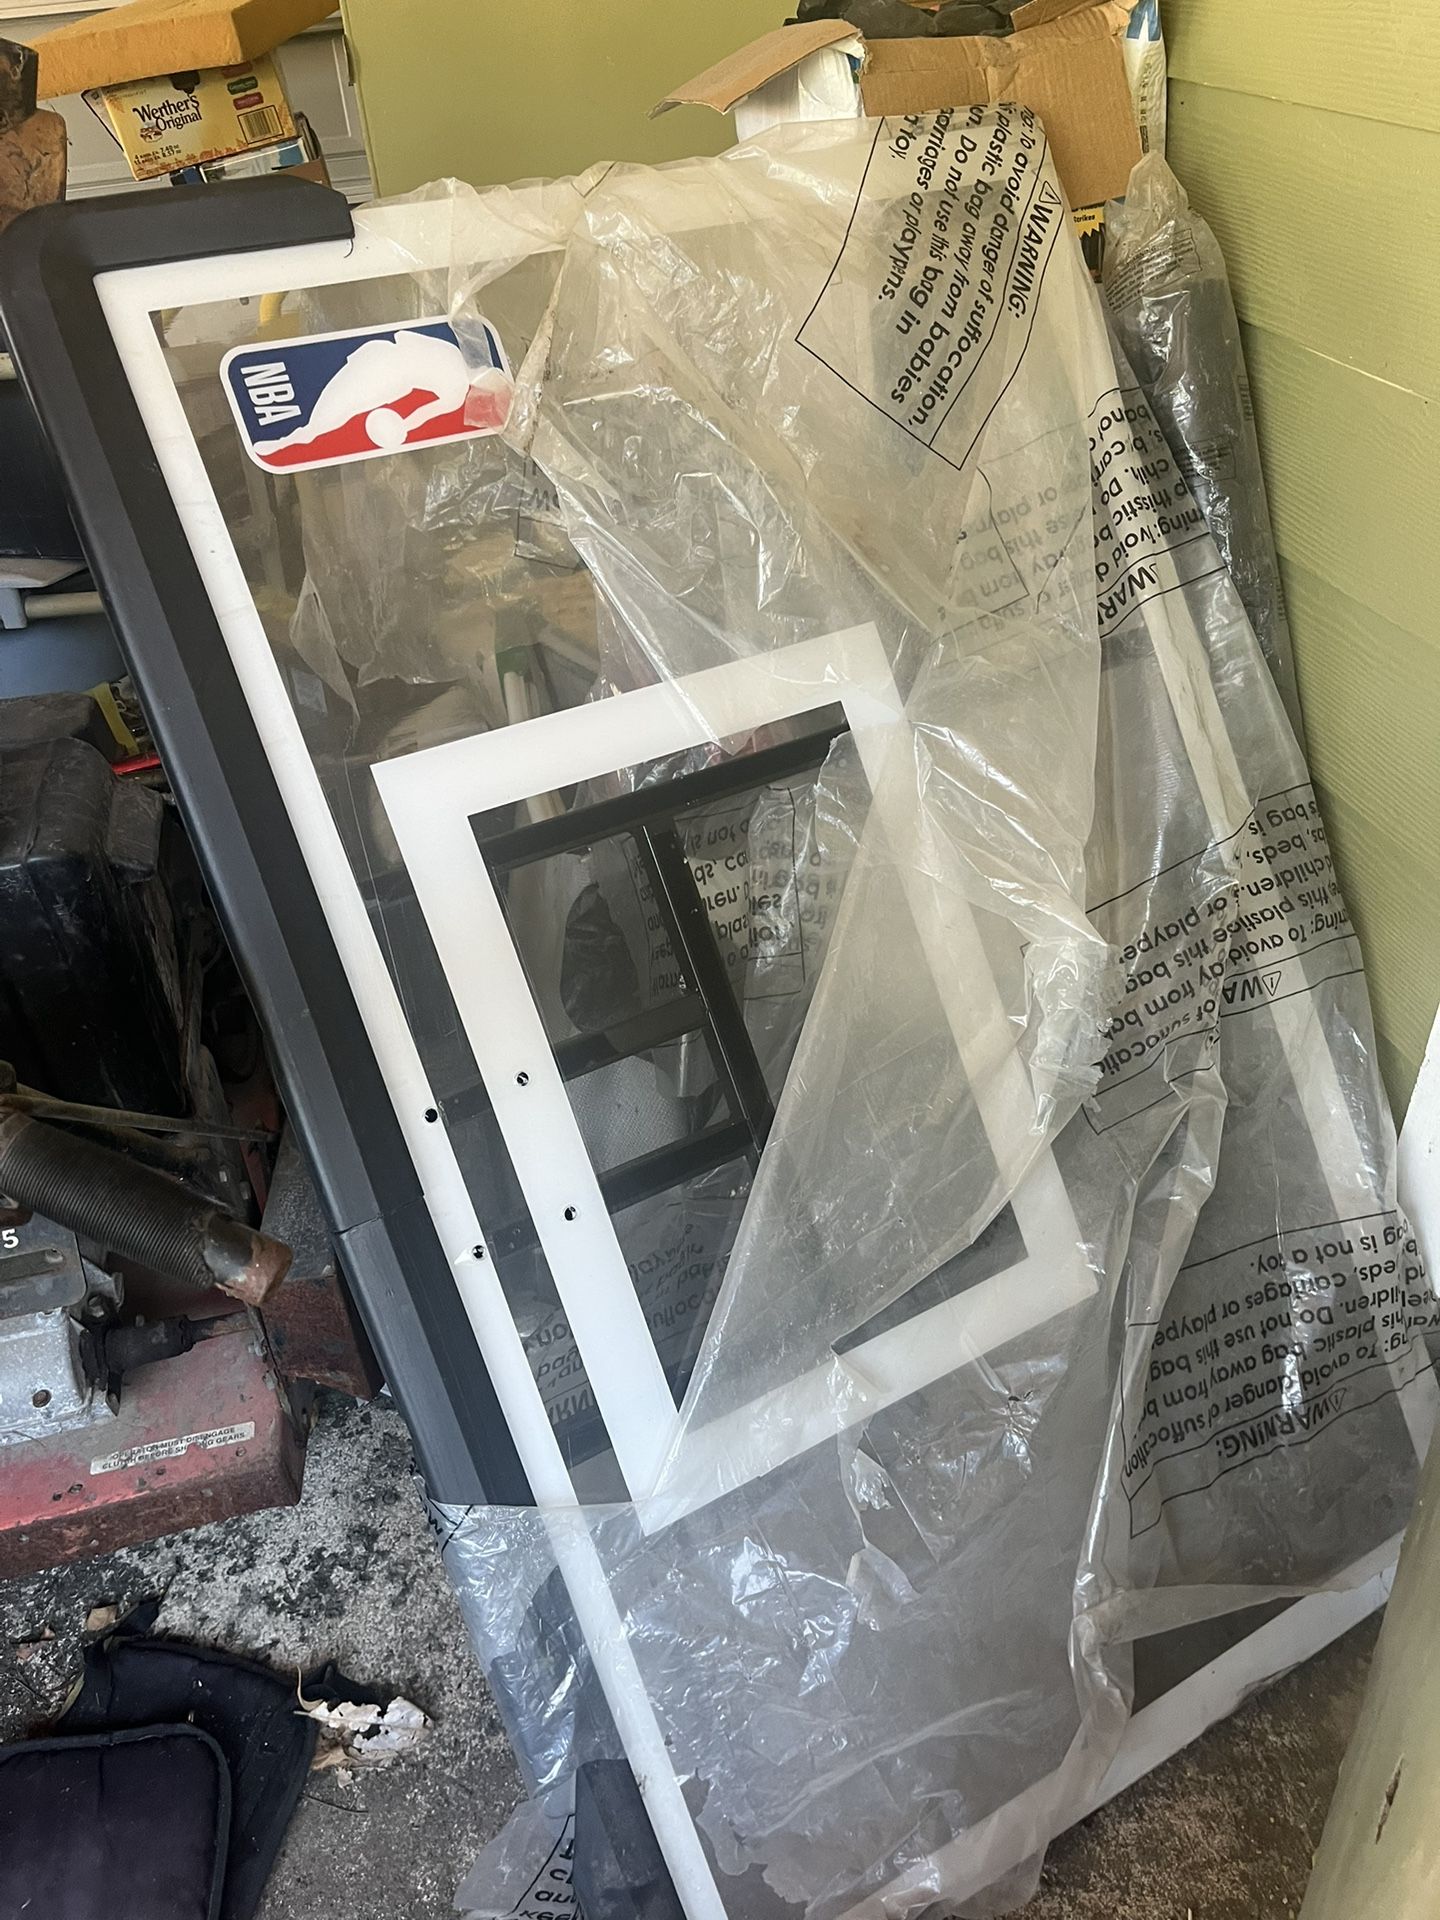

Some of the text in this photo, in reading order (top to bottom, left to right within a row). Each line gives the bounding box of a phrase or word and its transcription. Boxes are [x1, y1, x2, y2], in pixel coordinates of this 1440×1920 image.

[132, 94, 200, 123] Werther's
[155, 107, 202, 131] Original
[889, 128, 920, 160] toy.
[955, 135, 977, 163] Do
[982, 111, 1010, 176] plastic
[940, 166, 962, 201] not
[1000, 152, 1031, 215] avoid
[905, 192, 923, 215] or
[964, 179, 993, 220] bag
[934, 200, 953, 232] use
[878, 210, 922, 300] playpens.
[929, 233, 949, 261] this
[954, 222, 976, 271] away
[982, 213, 1009, 279] danger
[1008, 204, 1053, 318] WARNING:
[909, 266, 944, 309] bag
[941, 269, 969, 318] from
[977, 279, 994, 304] of
[896, 310, 920, 334] in
[891, 321, 950, 404] babies
[908, 300, 985, 425] suffocation,
[240, 361, 300, 427] NBA
[1248, 819, 1267, 836] is
[1266, 802, 1309, 827] bag
[1247, 834, 1307, 865] beds,
[1207, 897, 1227, 917] or
[1298, 887, 1329, 909] this
[1288, 924, 1307, 943] To
[1174, 938, 1212, 968] this
[1229, 935, 1283, 972] avoid
[1144, 980, 1195, 1015] from
[2, 1228, 19, 1249] 5
[1315, 1240, 1353, 1264] not
[1360, 1235, 1378, 1254] is
[1292, 1249, 1308, 1264] a
[1222, 1301, 1240, 1319] or
[1296, 1306, 1334, 1325] Do
[1224, 1325, 1255, 1348] use
[1260, 1312, 1295, 1339] not
[1313, 1315, 1376, 1352] plastic
[1196, 1340, 1219, 1365] this
[1356, 1342, 1377, 1359] To
[1149, 1355, 1192, 1382] bag
[1210, 1356, 1256, 1388] away
[1297, 1353, 1356, 1392] avoid
[215, 1432, 246, 1444] GEARS
[1216, 1396, 1333, 1458] WARNING:
